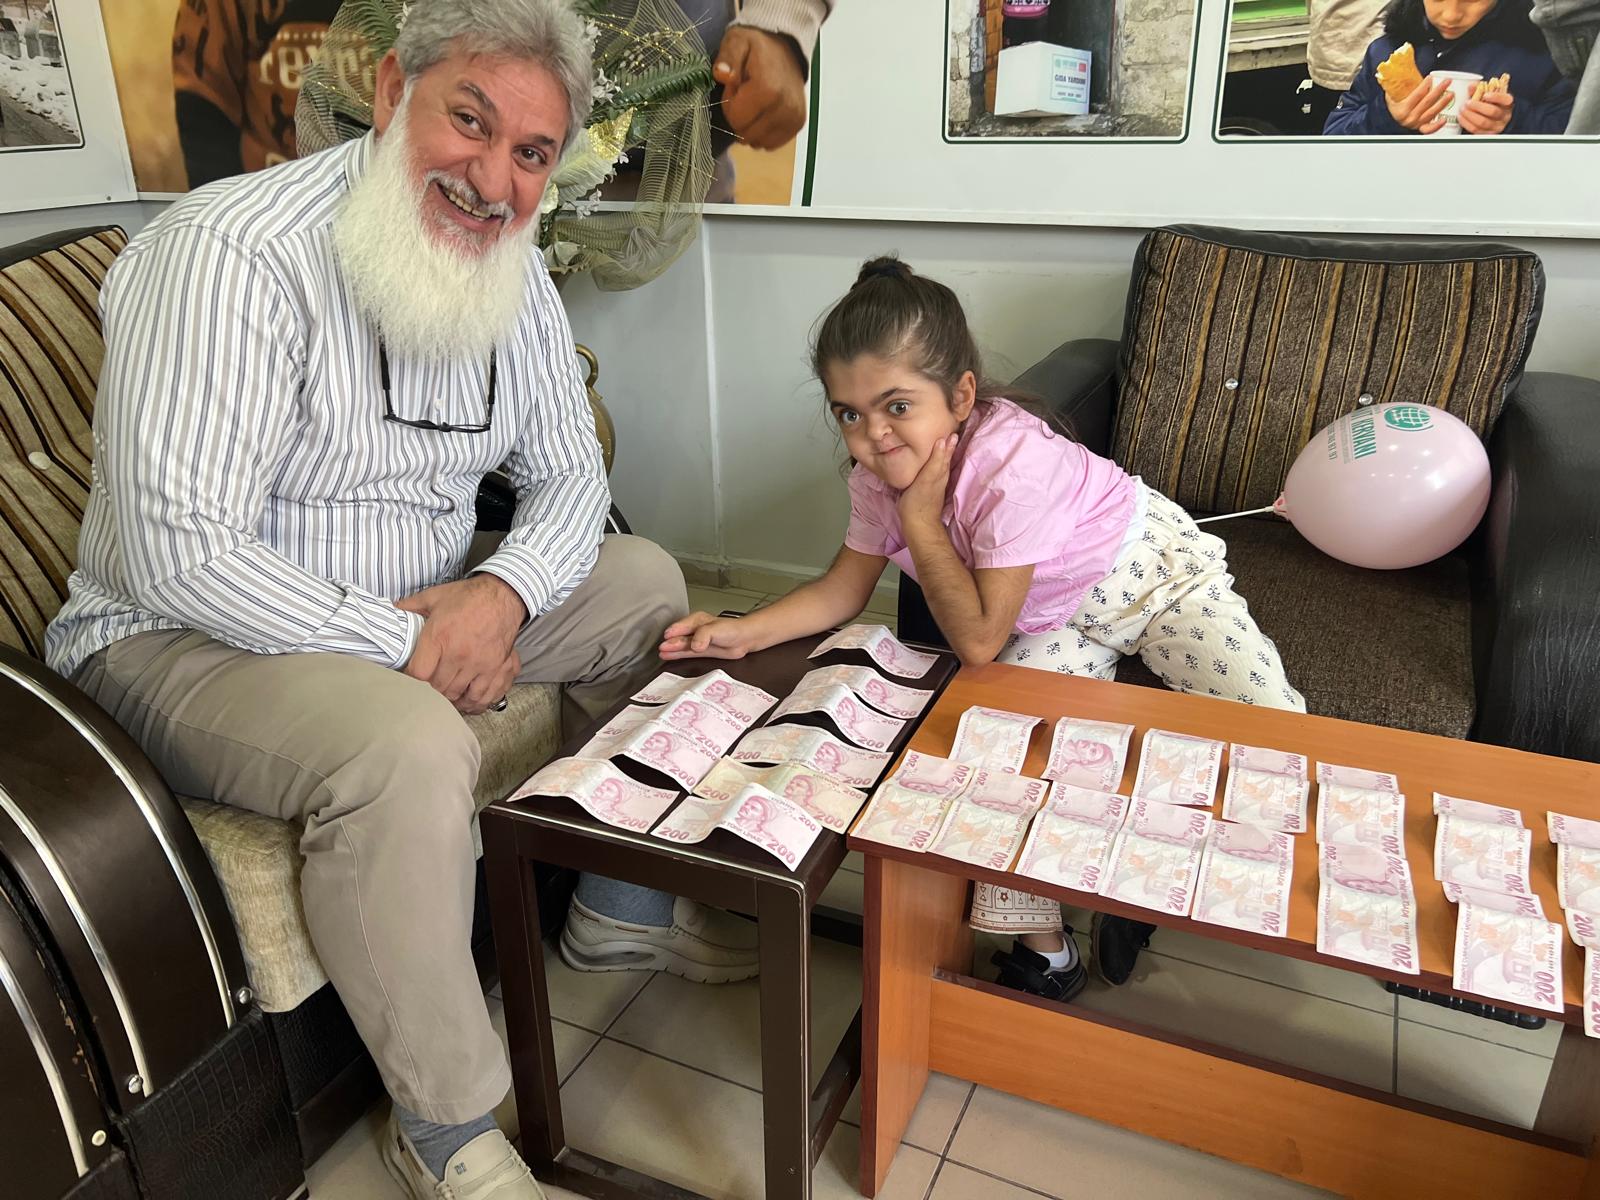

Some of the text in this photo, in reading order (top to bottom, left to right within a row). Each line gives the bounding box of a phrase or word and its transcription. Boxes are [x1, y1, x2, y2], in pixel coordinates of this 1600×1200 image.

[896, 669, 921, 678] 200
[756, 691, 773, 703] 200
[726, 708, 751, 723] 200
[891, 707, 918, 717] 200
[725, 718, 742, 731] 200
[696, 734, 721, 754] 200
[857, 736, 885, 749] 200
[700, 749, 717, 761] 200
[735, 751, 762, 760] 200
[906, 754, 919, 768] 200
[669, 765, 697, 787] 200
[843, 776, 872, 786] 200
[952, 765, 970, 784] 200
[975, 771, 988, 786] 200
[654, 792, 673, 800] 200
[703, 786, 730, 801] 200
[843, 788, 863, 799] 200
[1024, 781, 1042, 803] 200
[1055, 785, 1067, 800] 200
[1106, 796, 1124, 818] 200
[1135, 801, 1148, 817] 200
[618, 815, 649, 829] 200
[799, 814, 817, 832] 200
[815, 811, 844, 829] 200
[1189, 813, 1207, 836] 200
[1283, 813, 1300, 830] 200
[658, 826, 690, 841] 200
[910, 830, 931, 849] 200
[766, 839, 796, 865] 200
[1325, 845, 1337, 860] 200
[1381, 834, 1400, 855] 200
[987, 851, 1009, 869] 200
[1081, 865, 1101, 889] 200
[1504, 873, 1525, 894] 200
[1167, 886, 1188, 912] 200
[1261, 911, 1281, 934] 200
[1573, 913, 1596, 938] 200
[1391, 943, 1412, 969] 200
[1533, 971, 1556, 1005] 200
